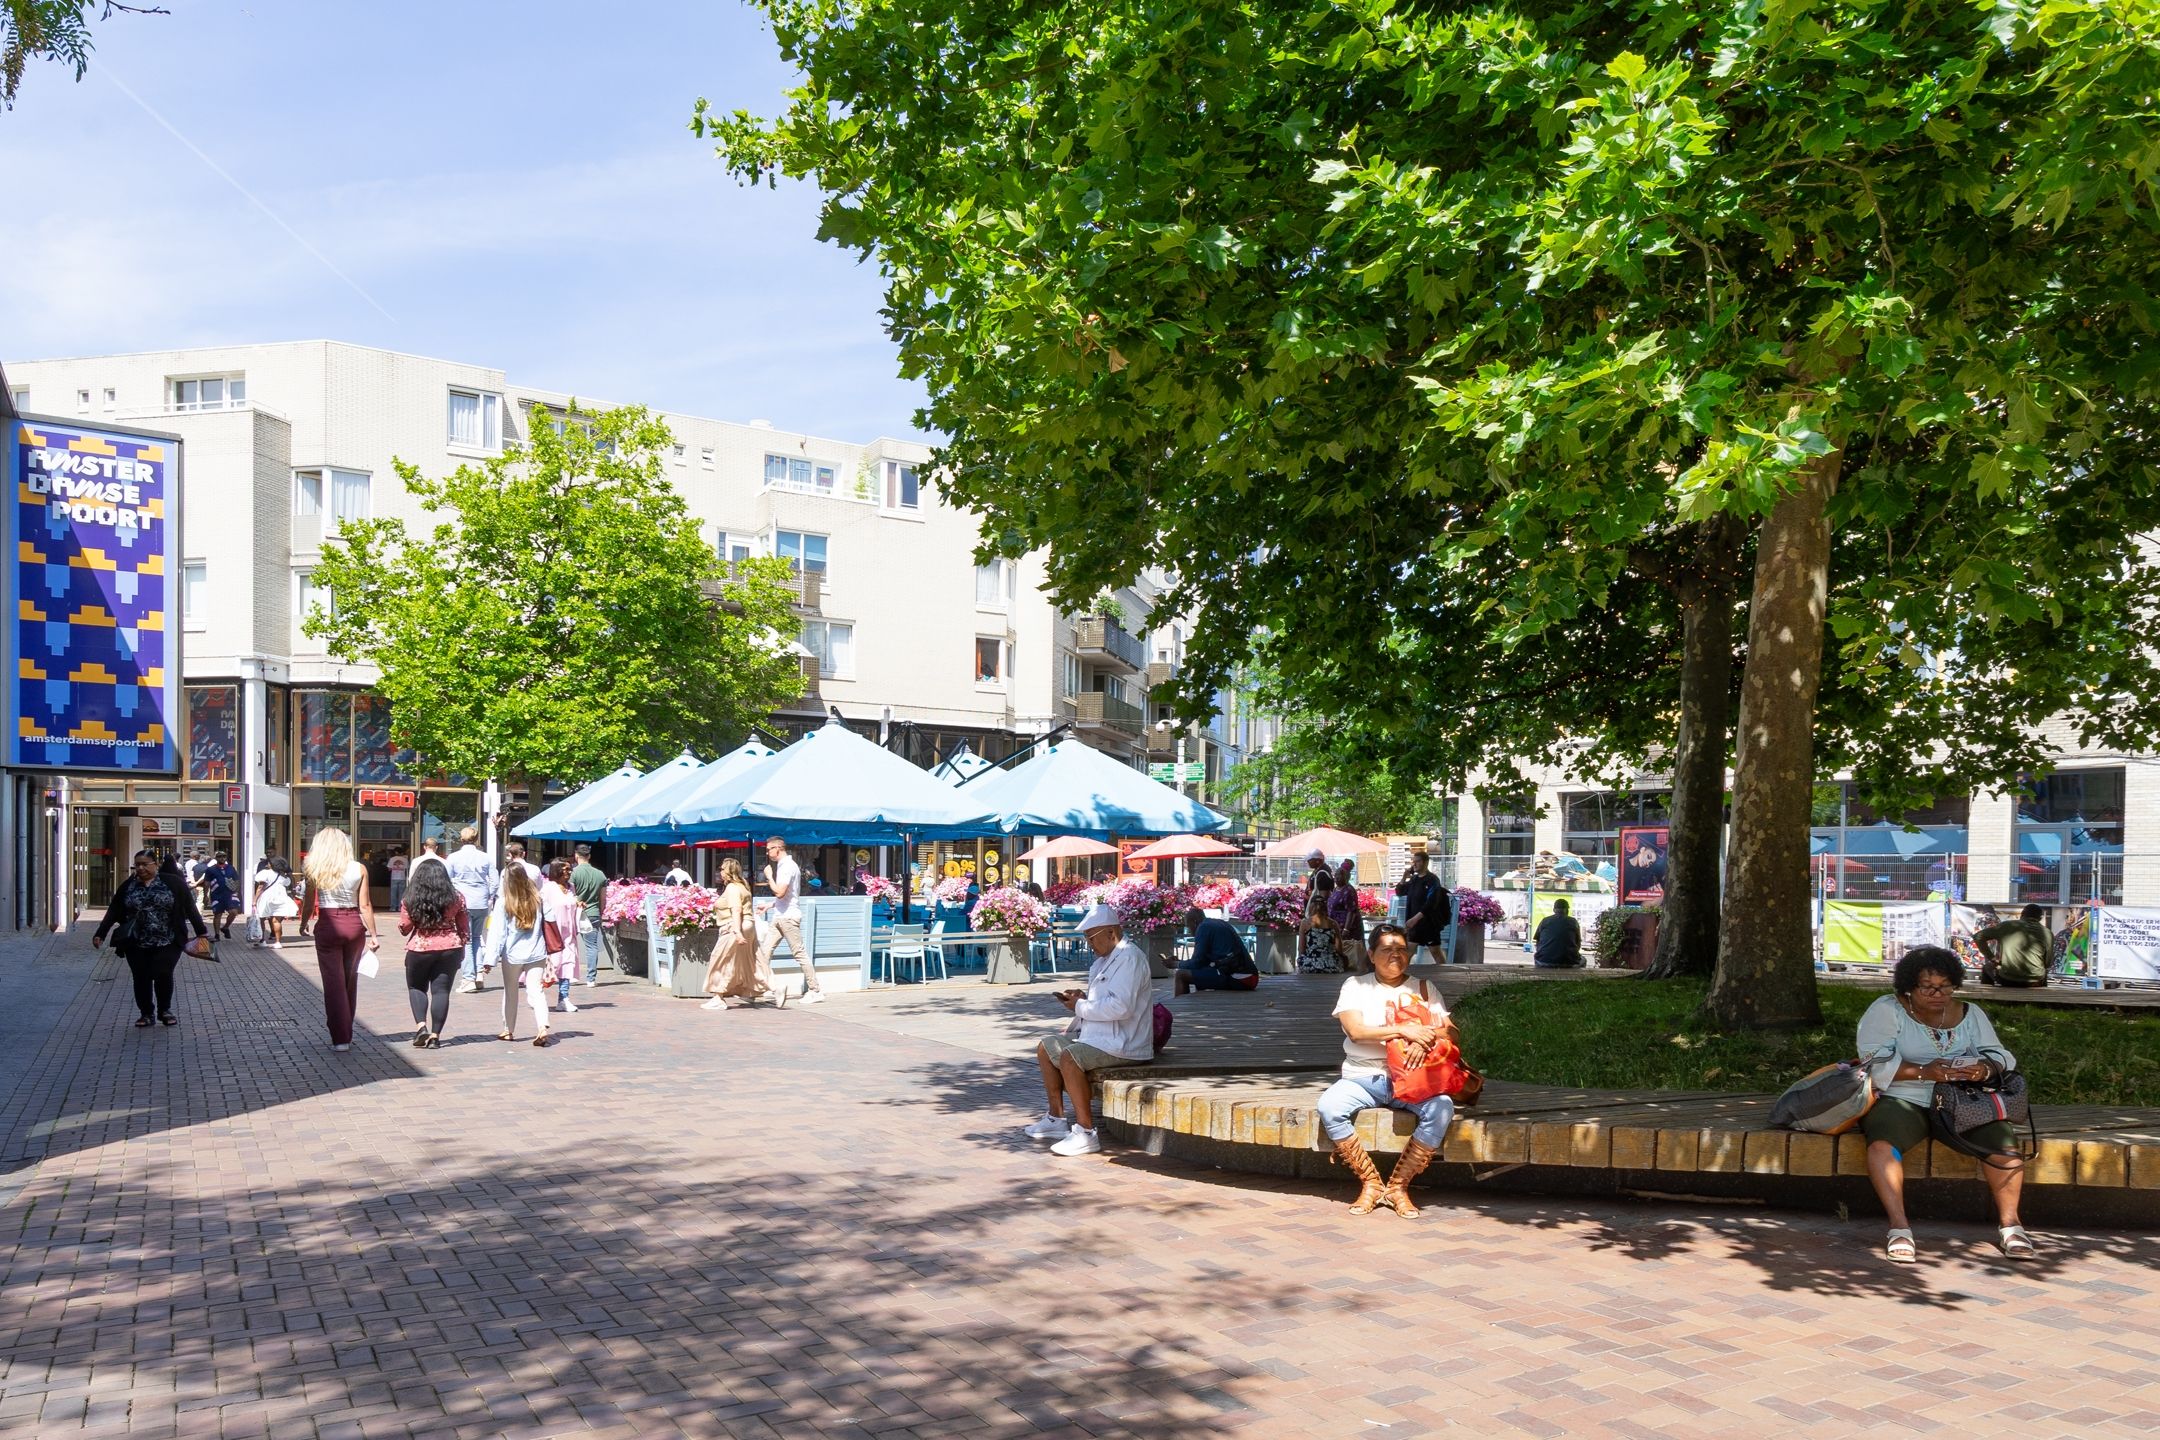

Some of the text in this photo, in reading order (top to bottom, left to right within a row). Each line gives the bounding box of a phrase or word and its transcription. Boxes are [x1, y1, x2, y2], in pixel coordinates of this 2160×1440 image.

[28, 449, 155, 483] AMSTER
[28, 473, 141, 505] DAMSE
[52, 500, 156, 530] POORT
[24, 733, 156, 750] amsterdamsepoort.nl
[227, 786, 241, 808] F
[358, 789, 415, 808] FEBO
